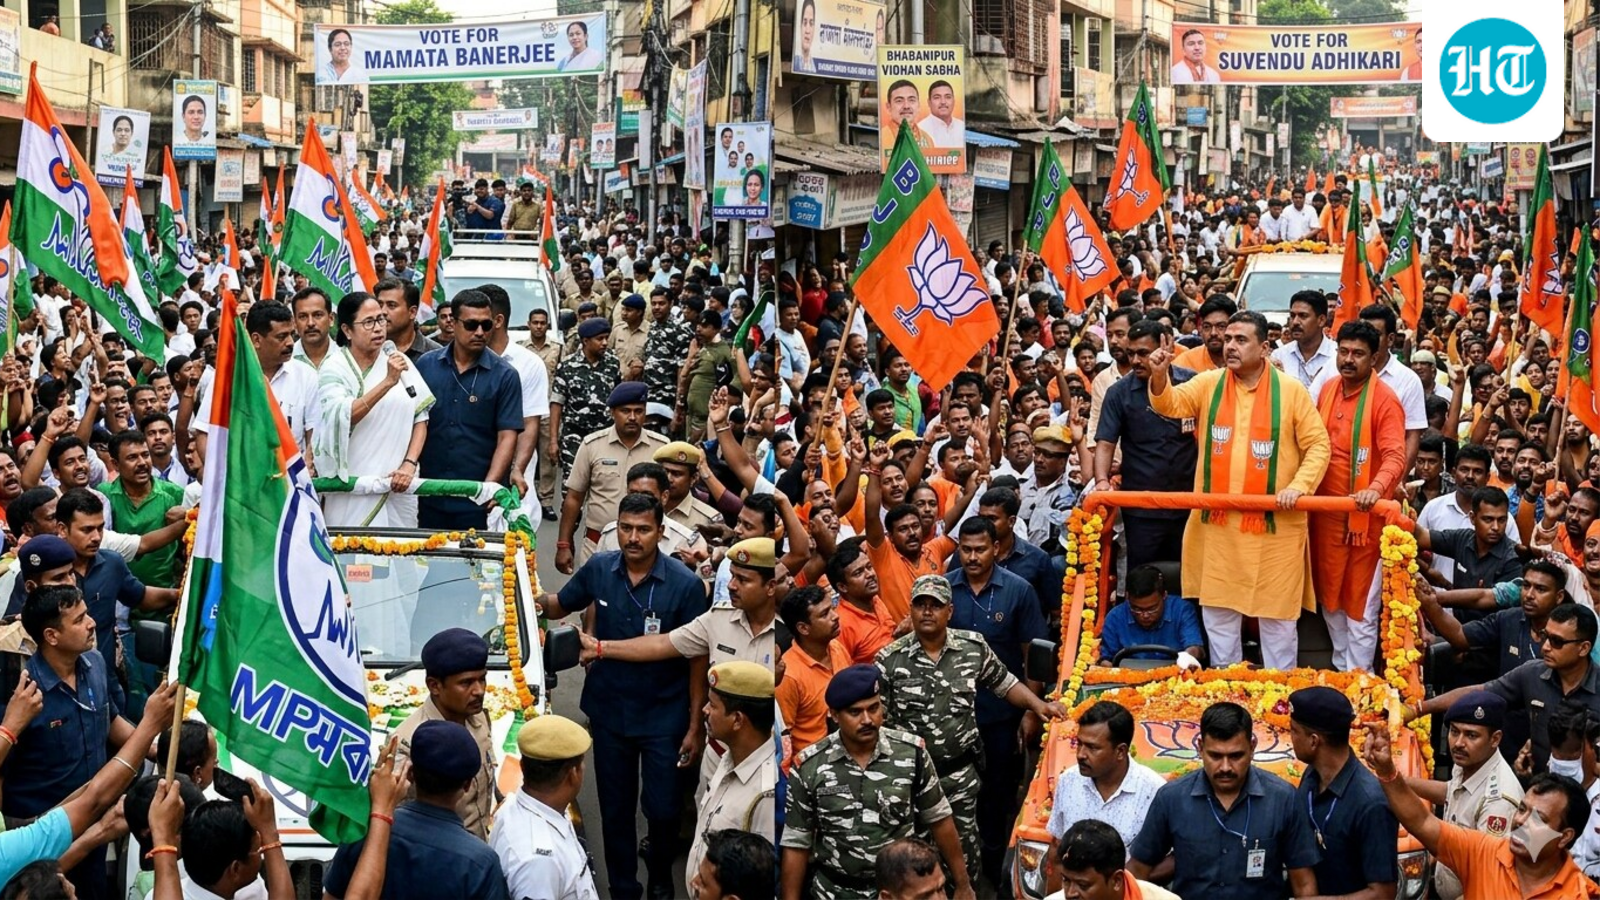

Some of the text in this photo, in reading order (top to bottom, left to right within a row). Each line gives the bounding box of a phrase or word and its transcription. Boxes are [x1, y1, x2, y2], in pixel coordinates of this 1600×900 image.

[419, 27, 499, 45] VOTE FOR
[1270, 32, 1348, 48] VOTE FOR
[364, 43, 556, 70] MAMATA BANERJEE
[886, 50, 956, 61] BHABANIPUR
[1218, 51, 1401, 71] SUVENDU ADHIKARI
